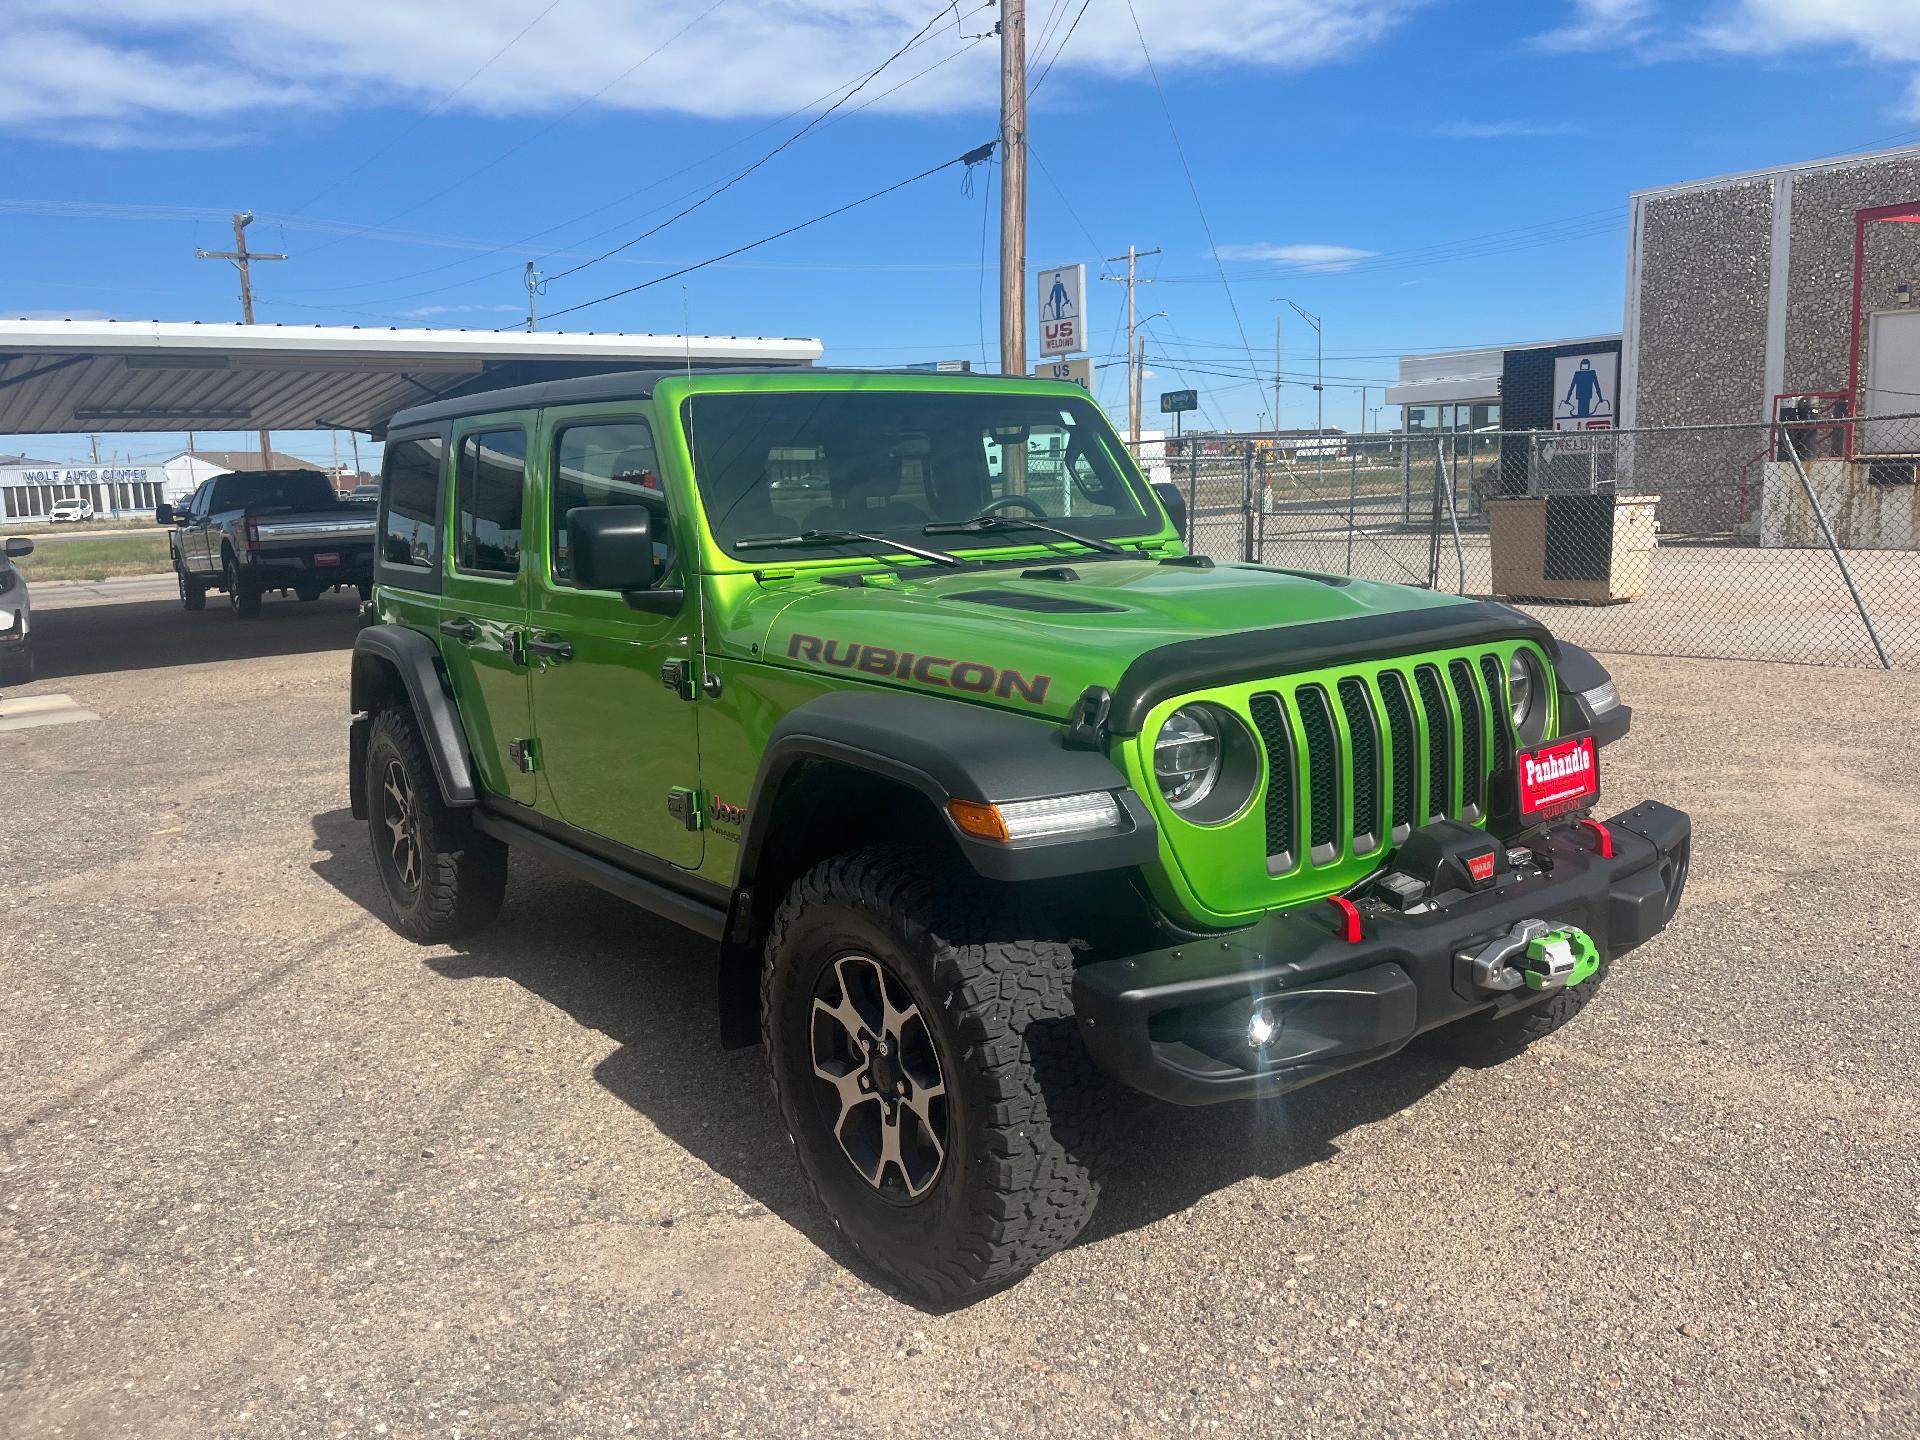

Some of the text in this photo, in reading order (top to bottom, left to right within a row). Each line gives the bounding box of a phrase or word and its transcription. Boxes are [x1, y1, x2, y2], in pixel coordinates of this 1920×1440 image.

[1045, 322, 1073, 339] US
[1046, 338, 1073, 349] WELDING
[1053, 364, 1070, 378] US
[24, 469, 148, 482] WOLF AUTO CENTER
[787, 633, 1051, 705] RUBICON
[1525, 747, 1590, 786] Panhandle
[1542, 799, 1580, 820] RUBICON
